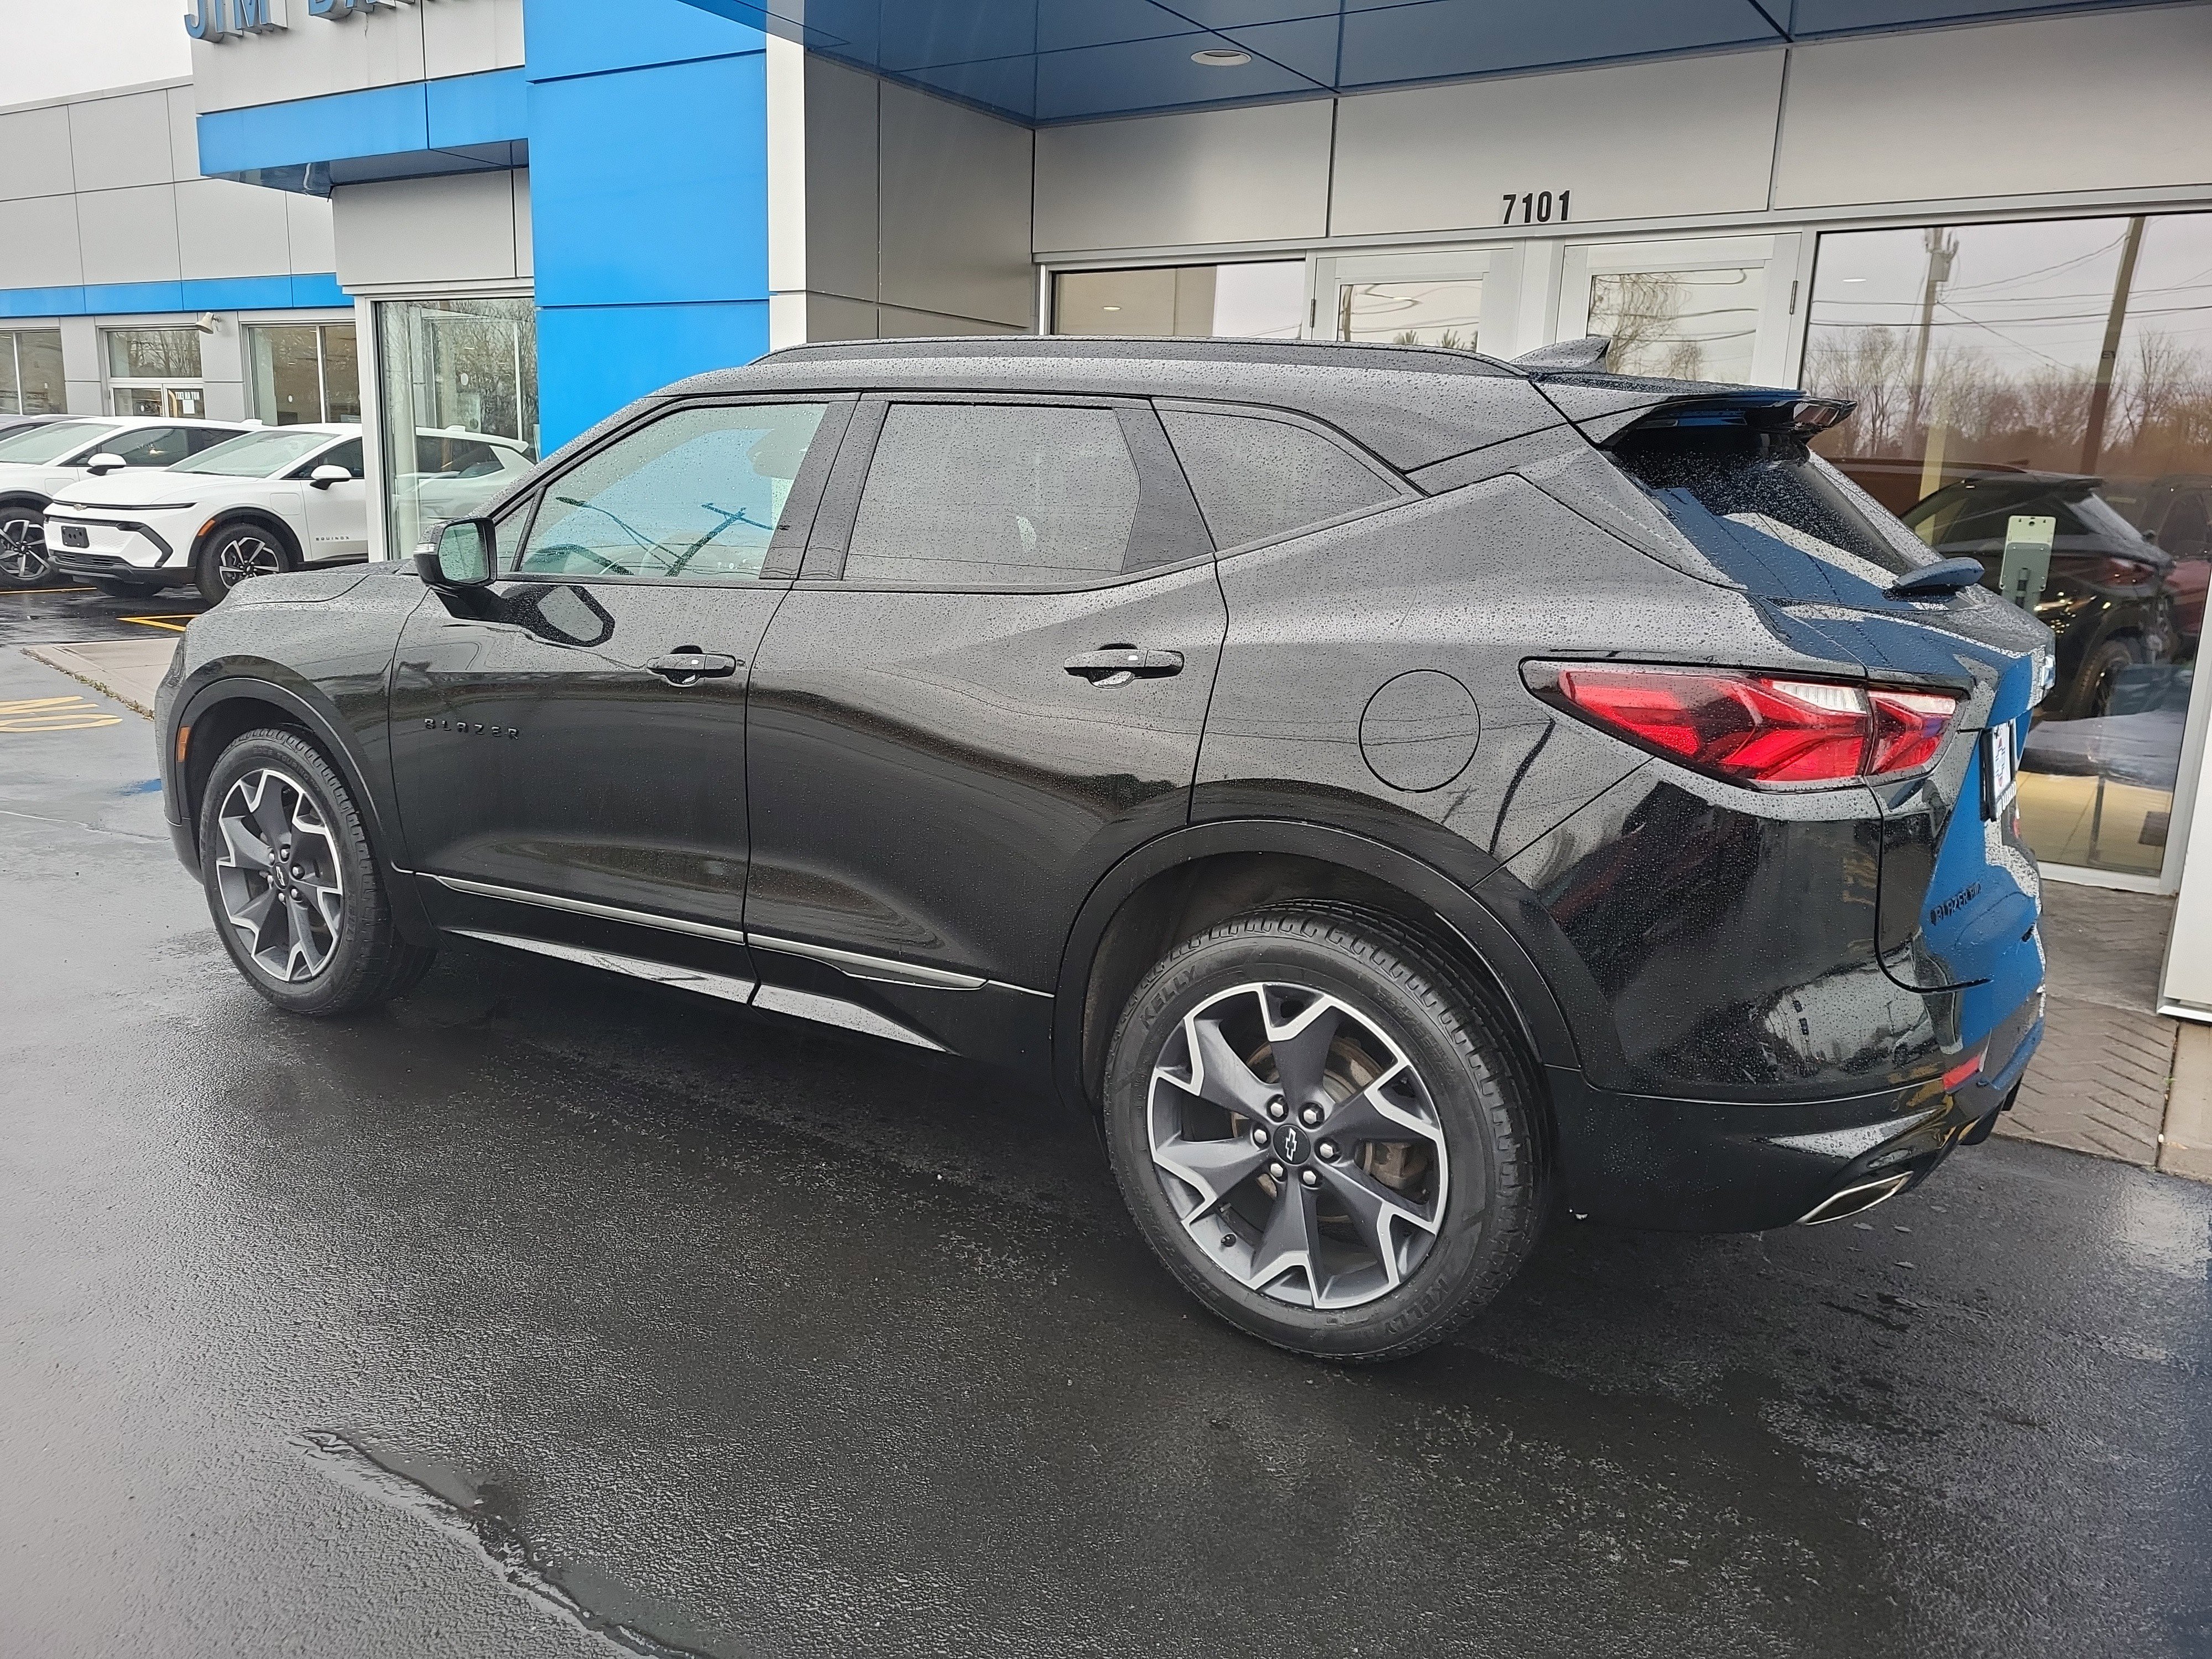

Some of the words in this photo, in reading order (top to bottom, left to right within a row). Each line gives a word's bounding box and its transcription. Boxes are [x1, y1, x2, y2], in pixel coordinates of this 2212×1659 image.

[1503, 190, 1571, 225] 7101
[424, 717, 520, 740] BLAZER
[1931, 891, 1968, 926] BLAZER
[1140, 964, 1196, 1030] KELLY
